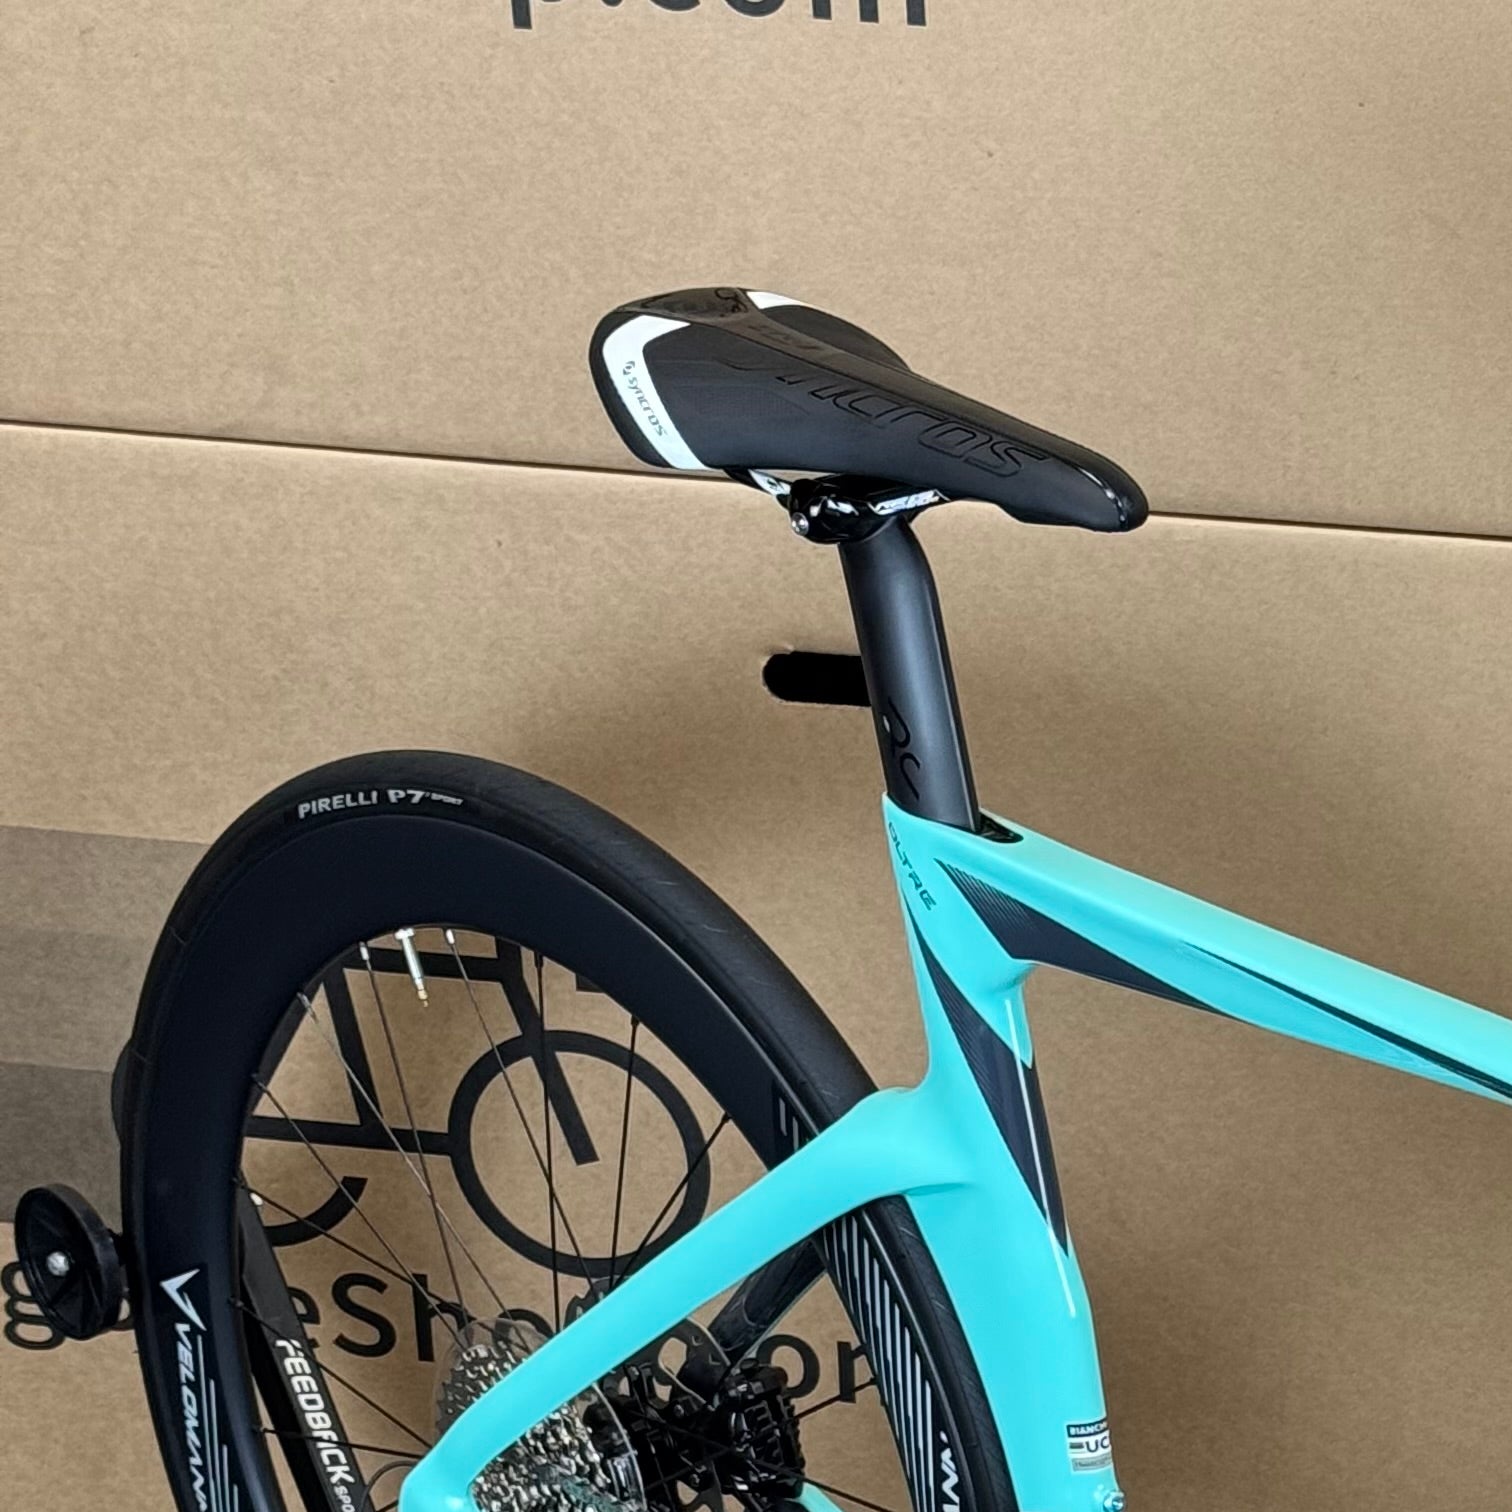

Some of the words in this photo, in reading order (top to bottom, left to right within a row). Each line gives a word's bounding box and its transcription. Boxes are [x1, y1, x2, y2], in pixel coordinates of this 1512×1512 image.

[627, 375, 668, 437] syncros
[297, 790, 378, 819] PIRELLI
[887, 821, 937, 911] OLTRE
[275, 1338, 355, 1484] FEEDBACK
